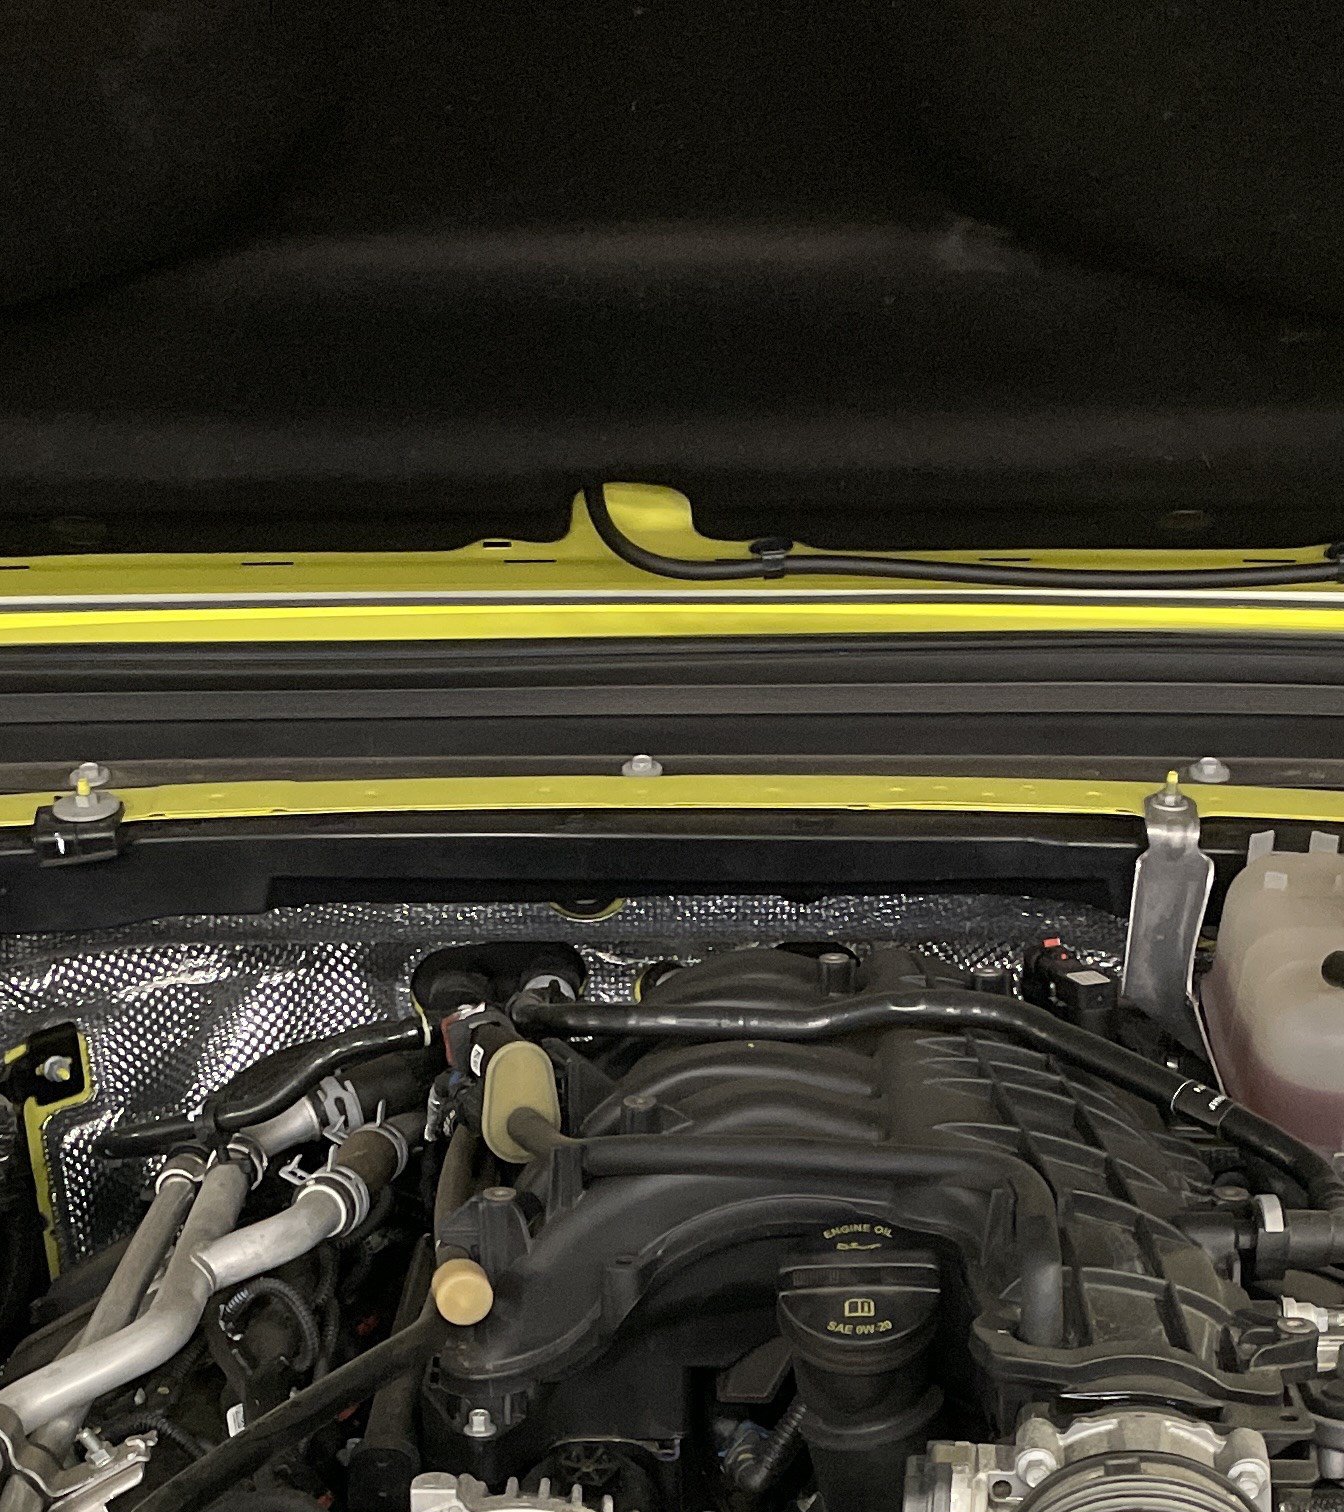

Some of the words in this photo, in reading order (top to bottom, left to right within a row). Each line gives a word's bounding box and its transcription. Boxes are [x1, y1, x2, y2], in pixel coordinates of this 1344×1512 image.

[823, 1223, 871, 1239] ENGINE
[874, 1224, 893, 1239] OIL
[827, 1320, 853, 1335] SAE
[856, 1319, 893, 1335] 0W-20
